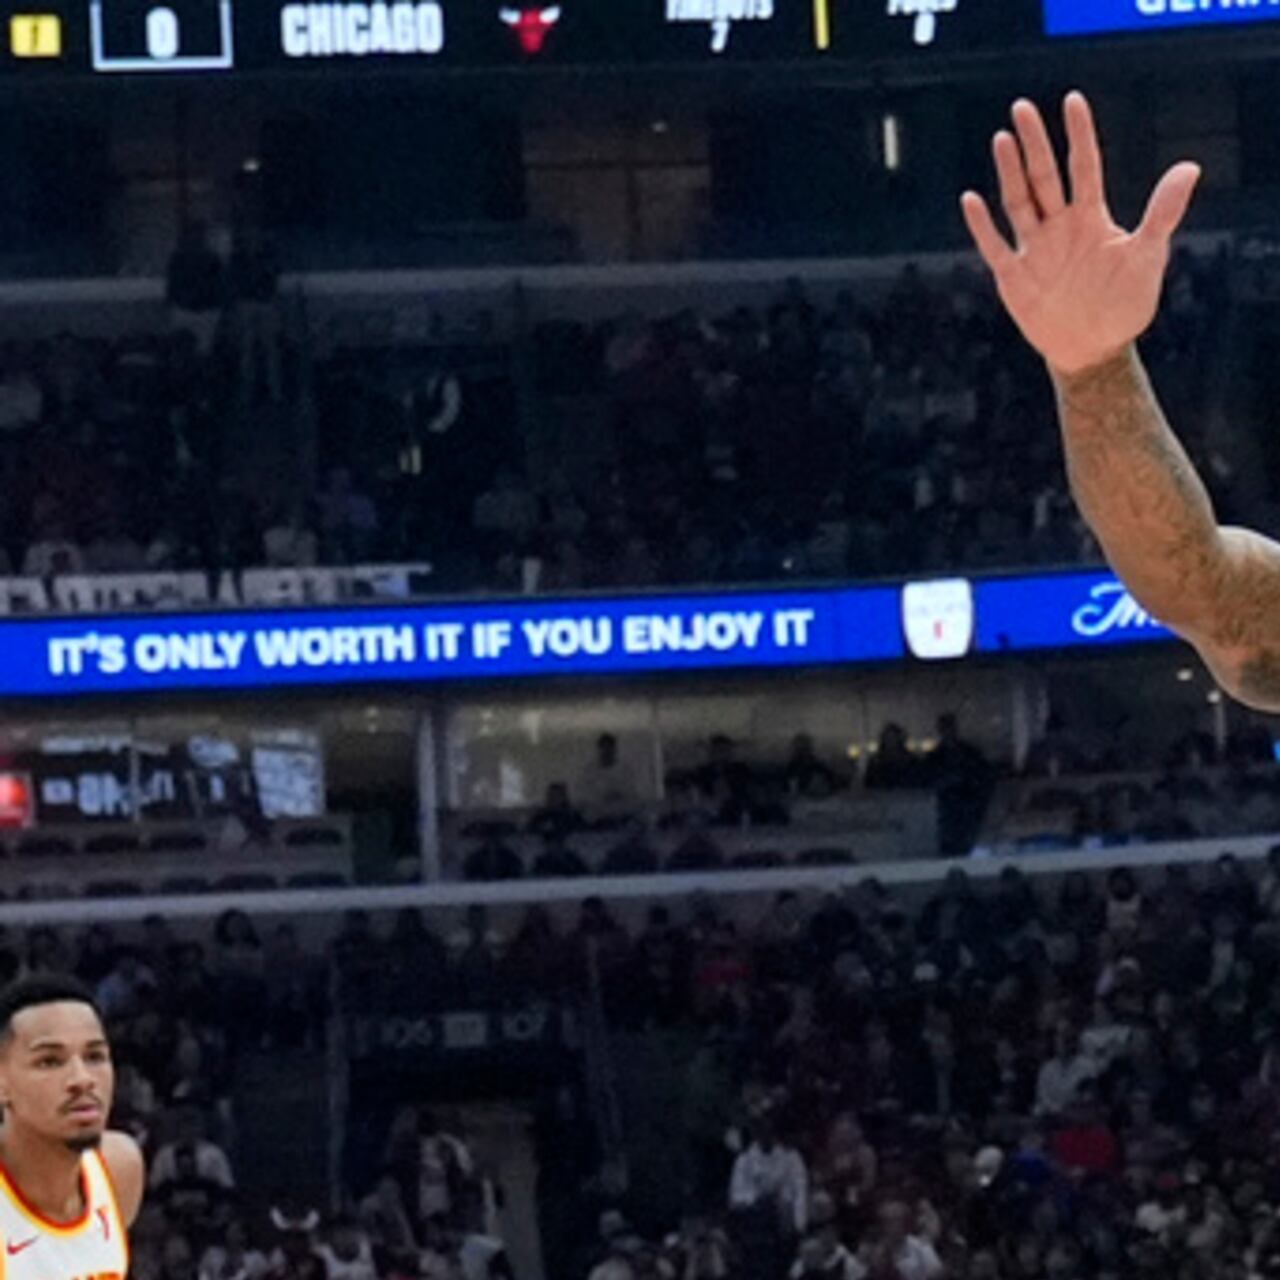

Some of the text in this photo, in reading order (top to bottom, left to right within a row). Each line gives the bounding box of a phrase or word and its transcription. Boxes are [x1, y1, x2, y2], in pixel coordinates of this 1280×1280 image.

[145, 7, 179, 60] 0
[281, 3, 444, 56] CHICAGO
[49, 613, 814, 675] IT'S ONLY WORTH IT IF YOU ENJOY IT
